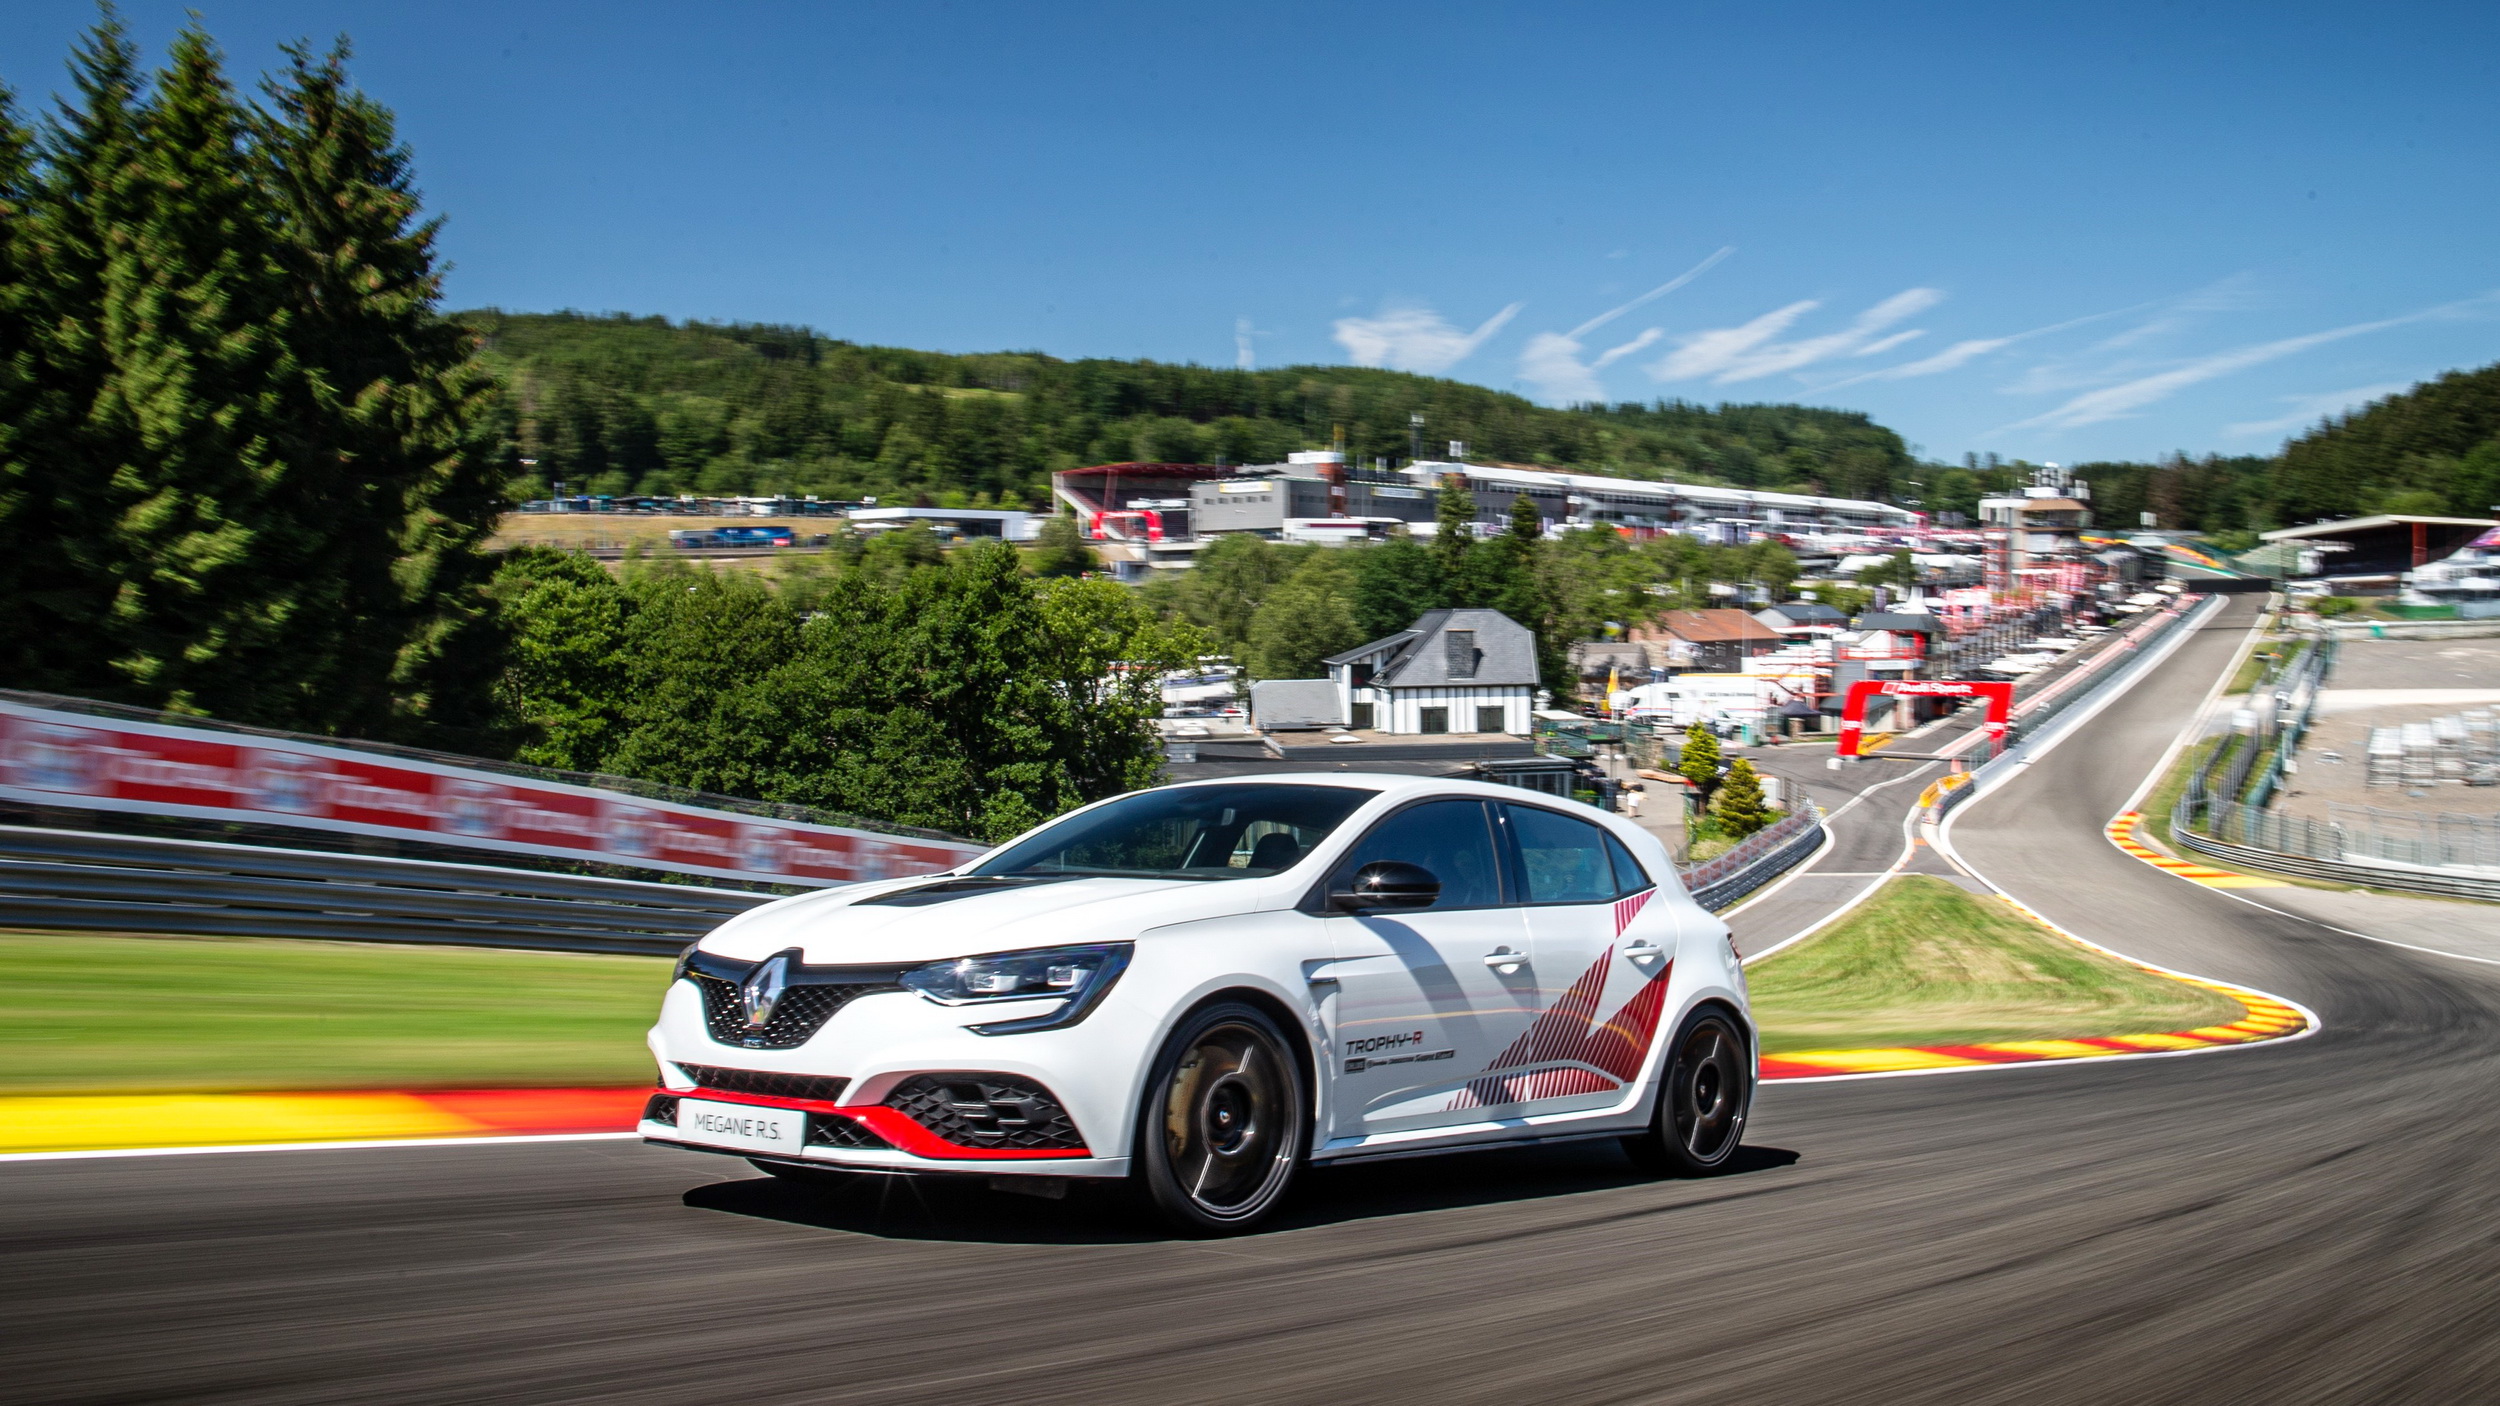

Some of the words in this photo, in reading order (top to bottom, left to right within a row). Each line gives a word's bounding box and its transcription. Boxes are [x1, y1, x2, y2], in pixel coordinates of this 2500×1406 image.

[1897, 682, 1930, 693] Audi
[1930, 683, 1973, 695] Sport
[1346, 1031, 1423, 1055] TROPHY-R
[694, 1113, 753, 1137] MEGANE
[756, 1120, 782, 1140] R.S.
